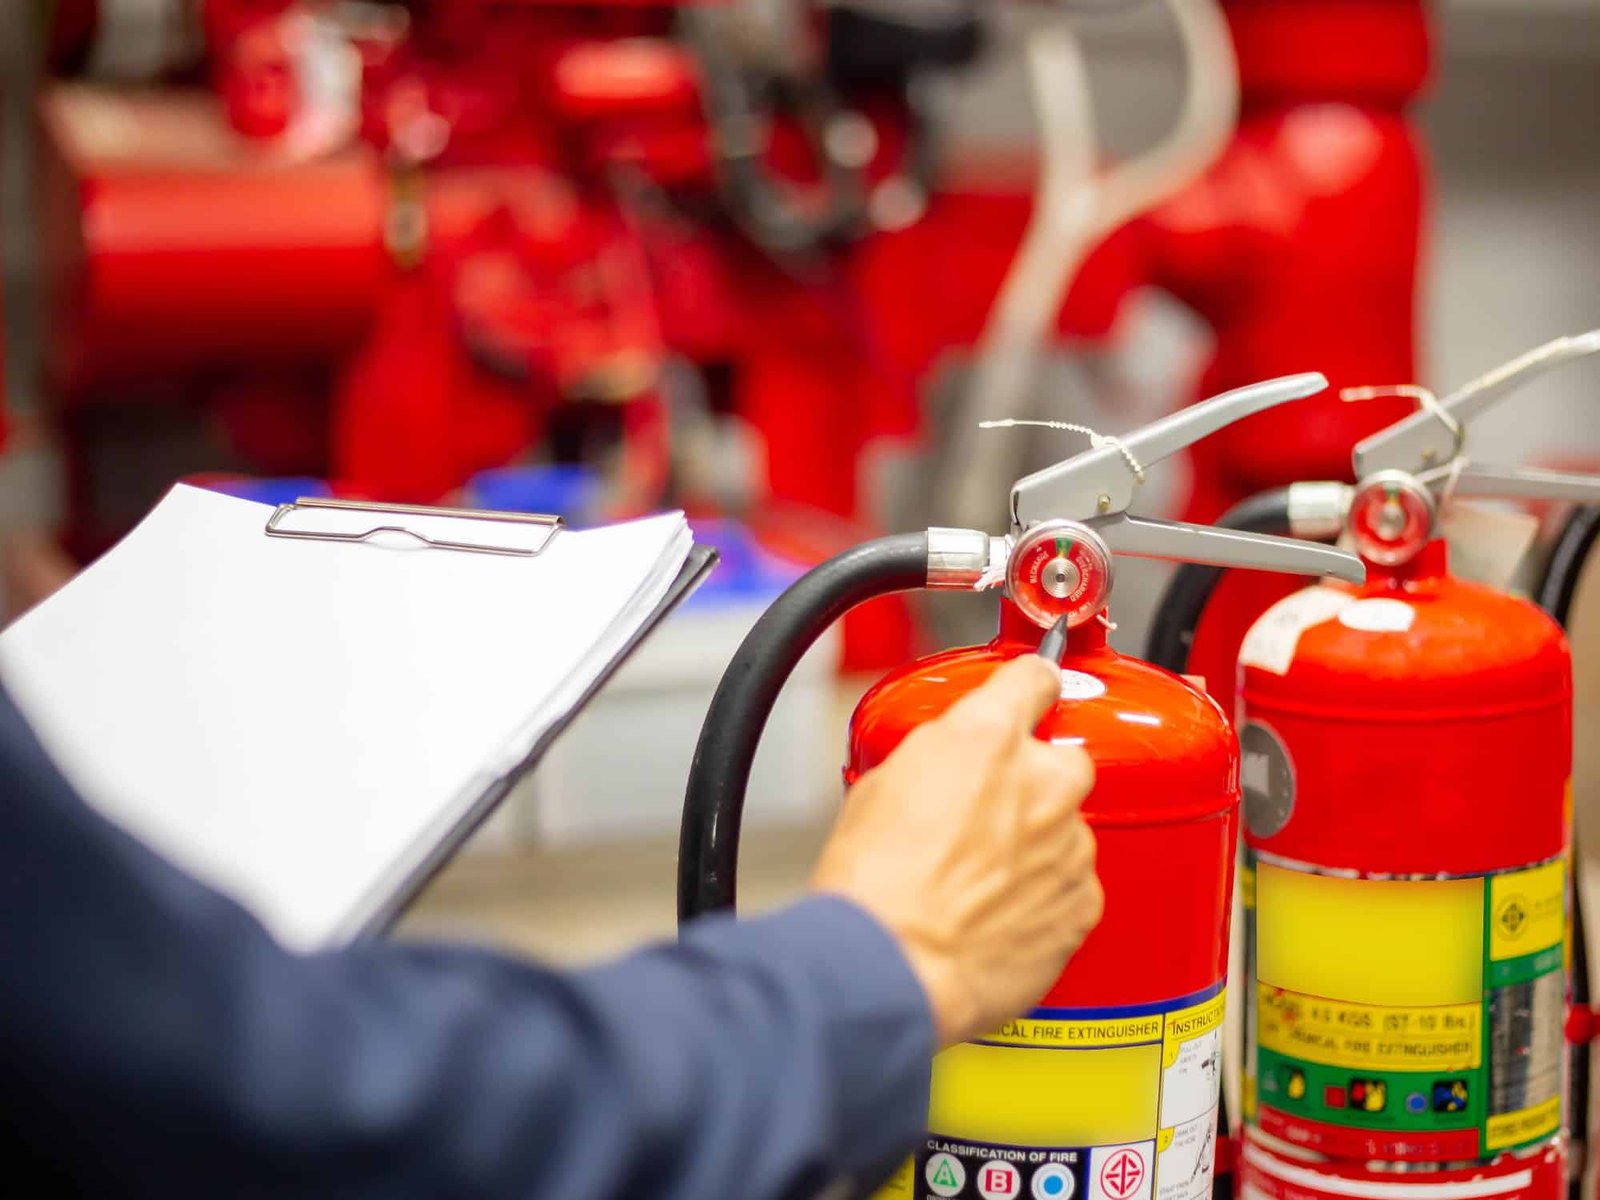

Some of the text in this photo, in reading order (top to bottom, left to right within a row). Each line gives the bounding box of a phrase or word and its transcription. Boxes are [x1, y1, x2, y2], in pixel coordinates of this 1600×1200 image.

[1033, 1025, 1063, 1040] FIRE
[1068, 1020, 1159, 1040] EXTINGUISHER
[927, 1140, 1078, 1163] CLASSIFICATION OF FIRE
[989, 1169, 1009, 1193] B
